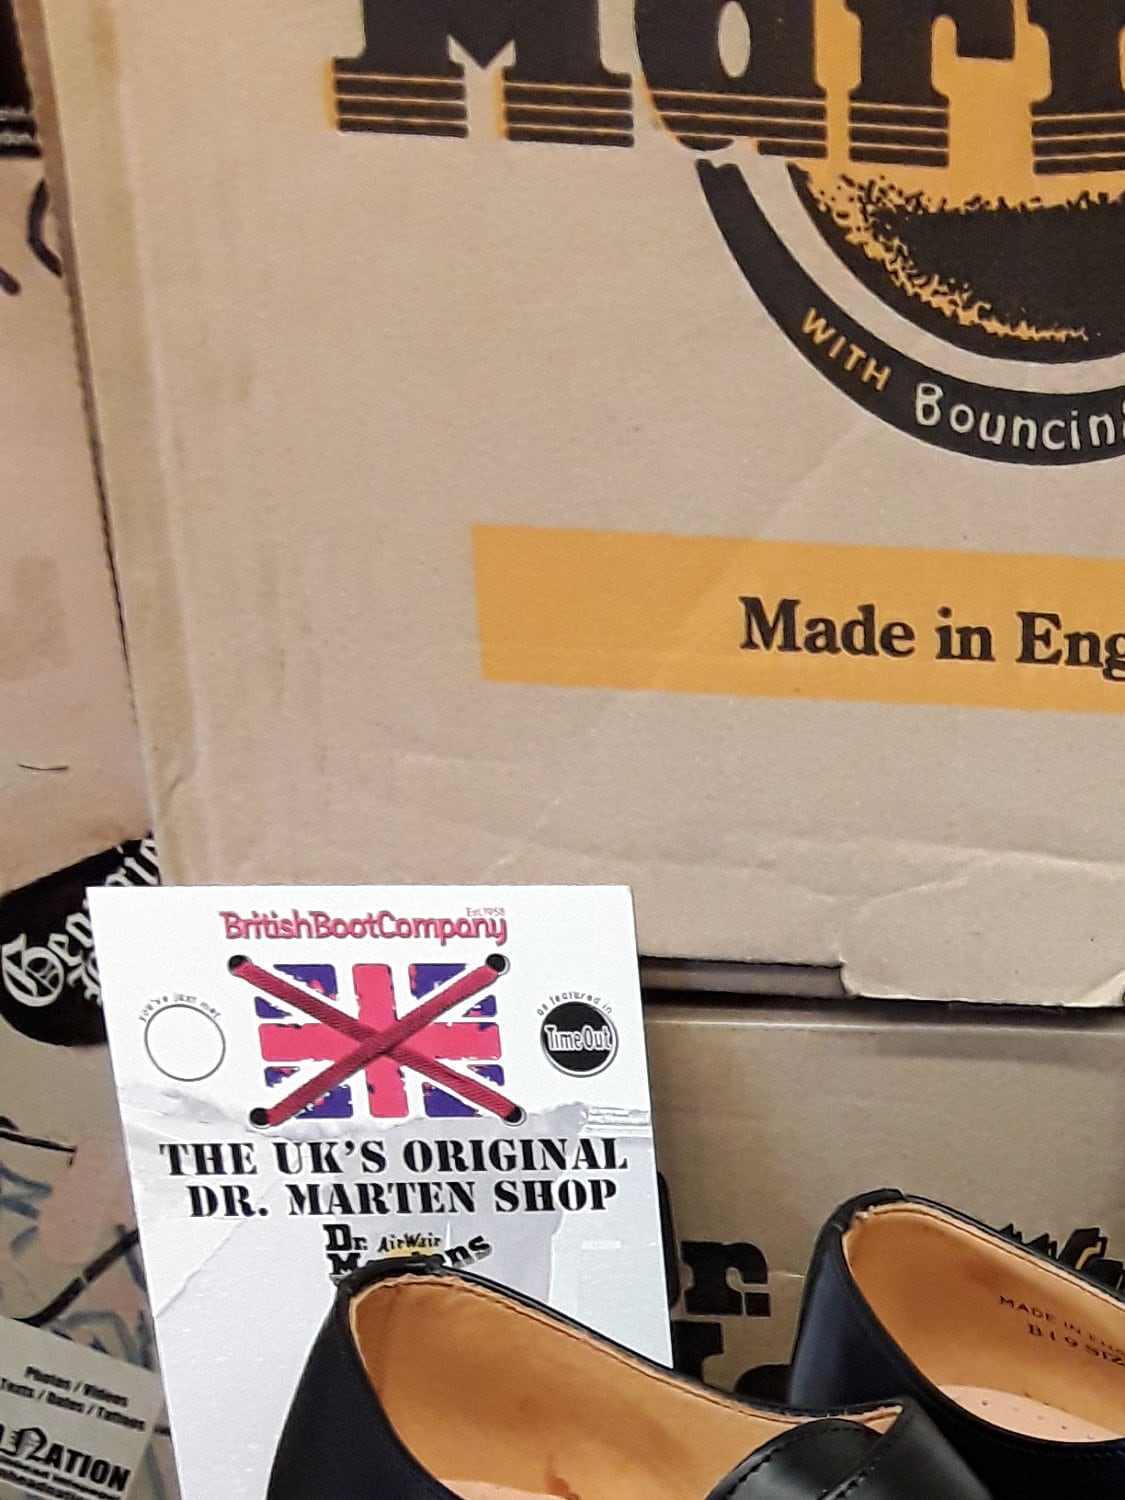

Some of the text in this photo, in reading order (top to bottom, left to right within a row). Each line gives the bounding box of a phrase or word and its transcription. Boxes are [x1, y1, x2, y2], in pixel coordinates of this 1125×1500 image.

[802, 306, 893, 393] WITH
[738, 596, 916, 658] Made
[934, 606, 996, 662] in
[219, 910, 507, 947] BritishBootCompany
[158, 1142, 258, 1177] THE
[402, 1136, 630, 1174] ORIGINAL
[185, 1178, 618, 1219] DR. MARTEN SHOP
[322, 1223, 369, 1252] Dr.
[1000, 1295, 1058, 1325] MADE
